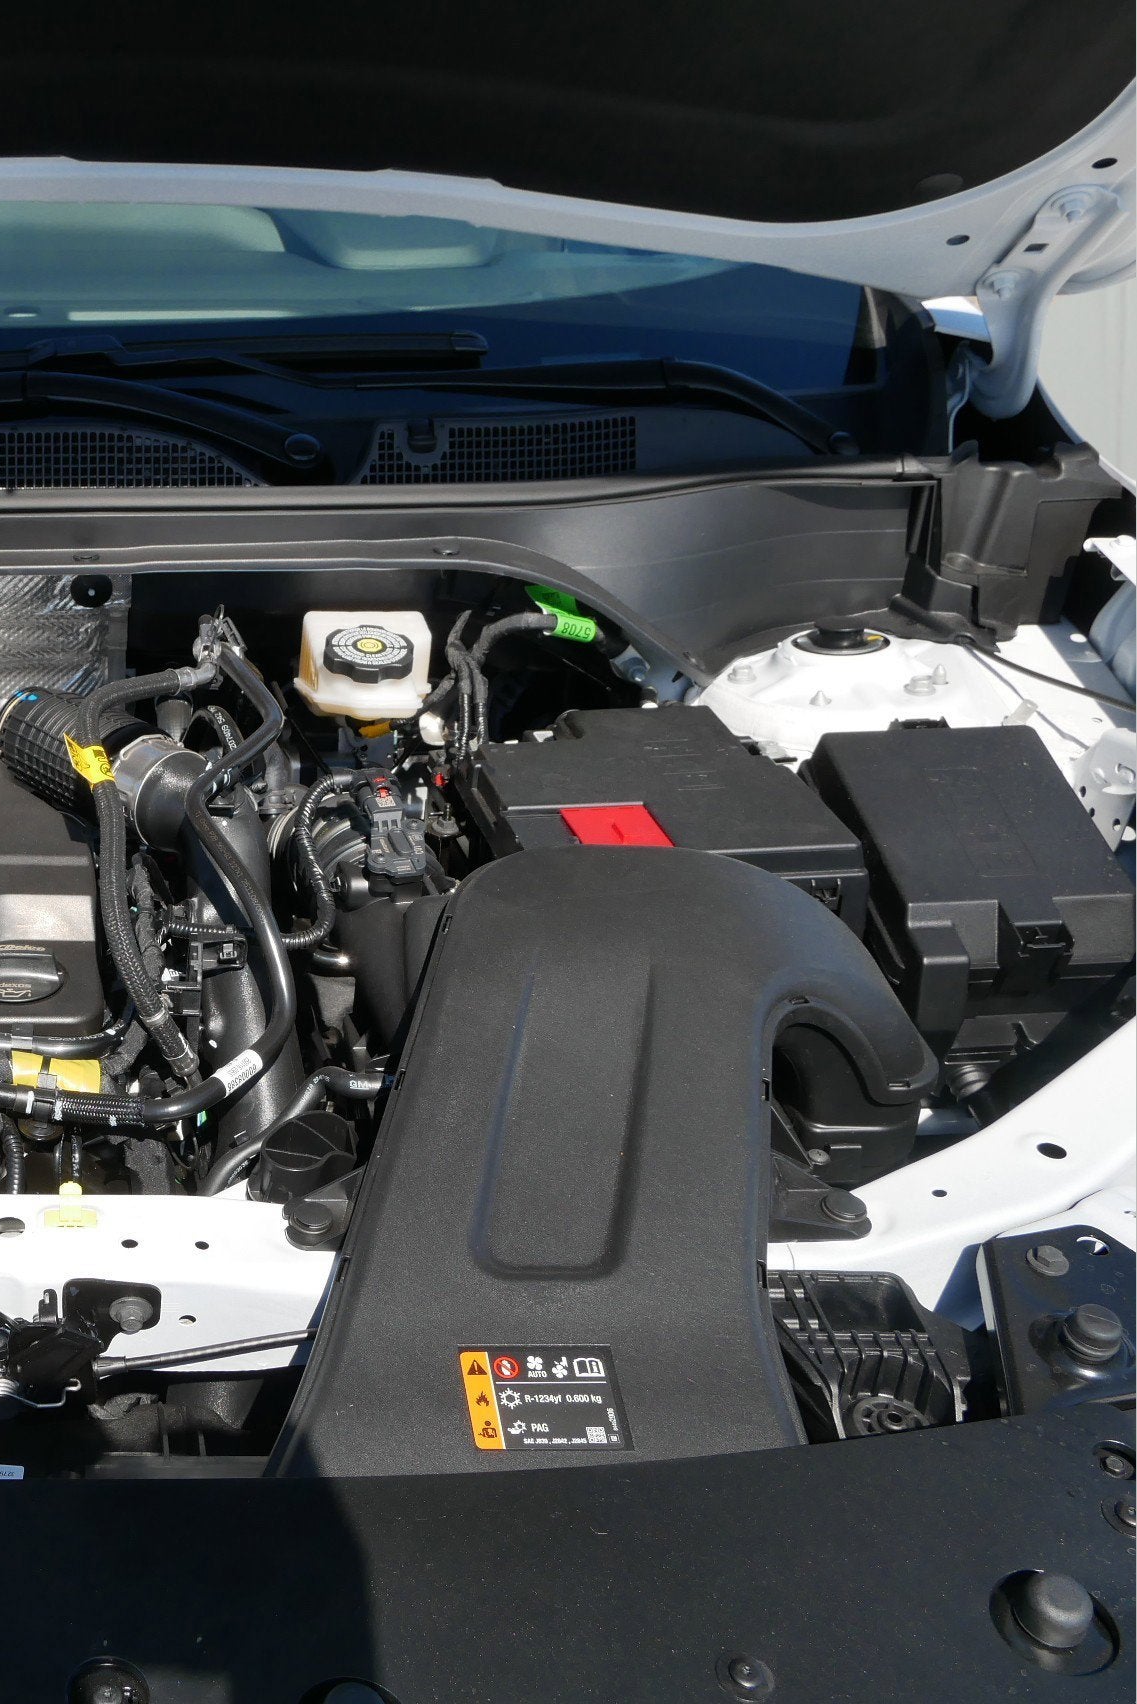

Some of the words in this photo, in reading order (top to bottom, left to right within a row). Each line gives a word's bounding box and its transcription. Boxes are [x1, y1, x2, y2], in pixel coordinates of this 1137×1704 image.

[561, 622, 592, 639] 5708
[528, 1370, 548, 1378] AUTO
[524, 1394, 562, 1404] R-1234yf
[566, 1395, 589, 1403] 0.600
[591, 1394, 602, 1404] kg
[531, 1423, 549, 1432] PAG
